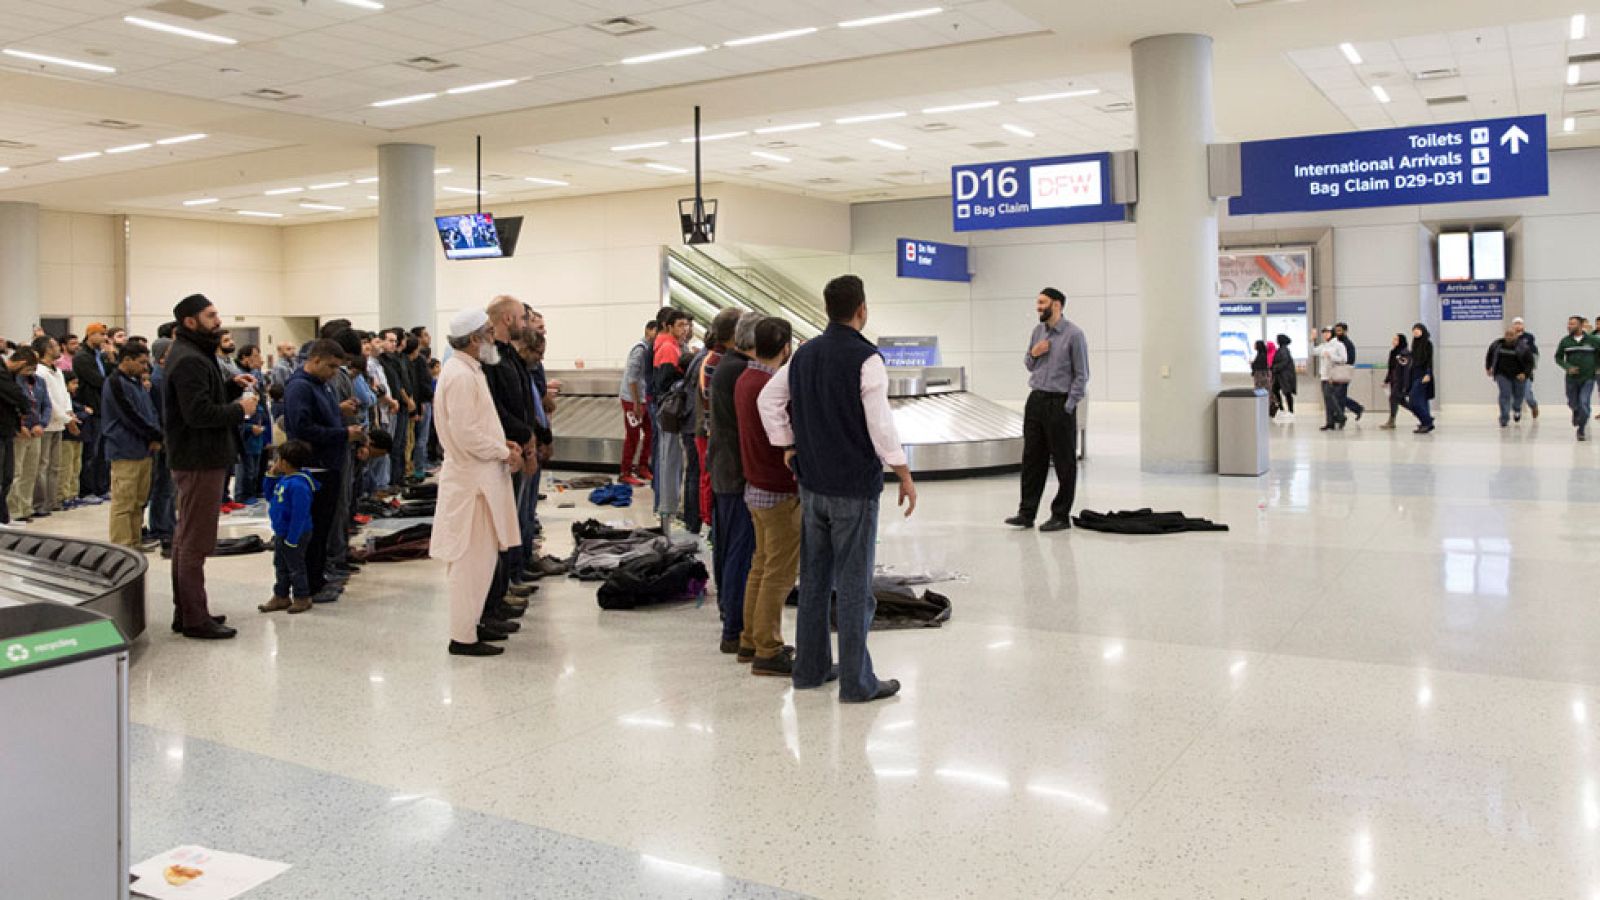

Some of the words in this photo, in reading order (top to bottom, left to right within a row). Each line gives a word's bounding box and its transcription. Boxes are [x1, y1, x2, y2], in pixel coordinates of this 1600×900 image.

[1409, 132, 1462, 148] Toilets
[1294, 157, 1394, 177] International
[1399, 152, 1462, 169] Arrivals
[956, 167, 1018, 200] D16
[1038, 172, 1092, 197] DFW
[1310, 182, 1339, 196] Bag
[1345, 178, 1389, 193] Claim
[1395, 171, 1463, 189] D29-D31
[974, 204, 995, 217] Bag
[998, 202, 1029, 214] Claim
[1220, 305, 1253, 313] rmation
